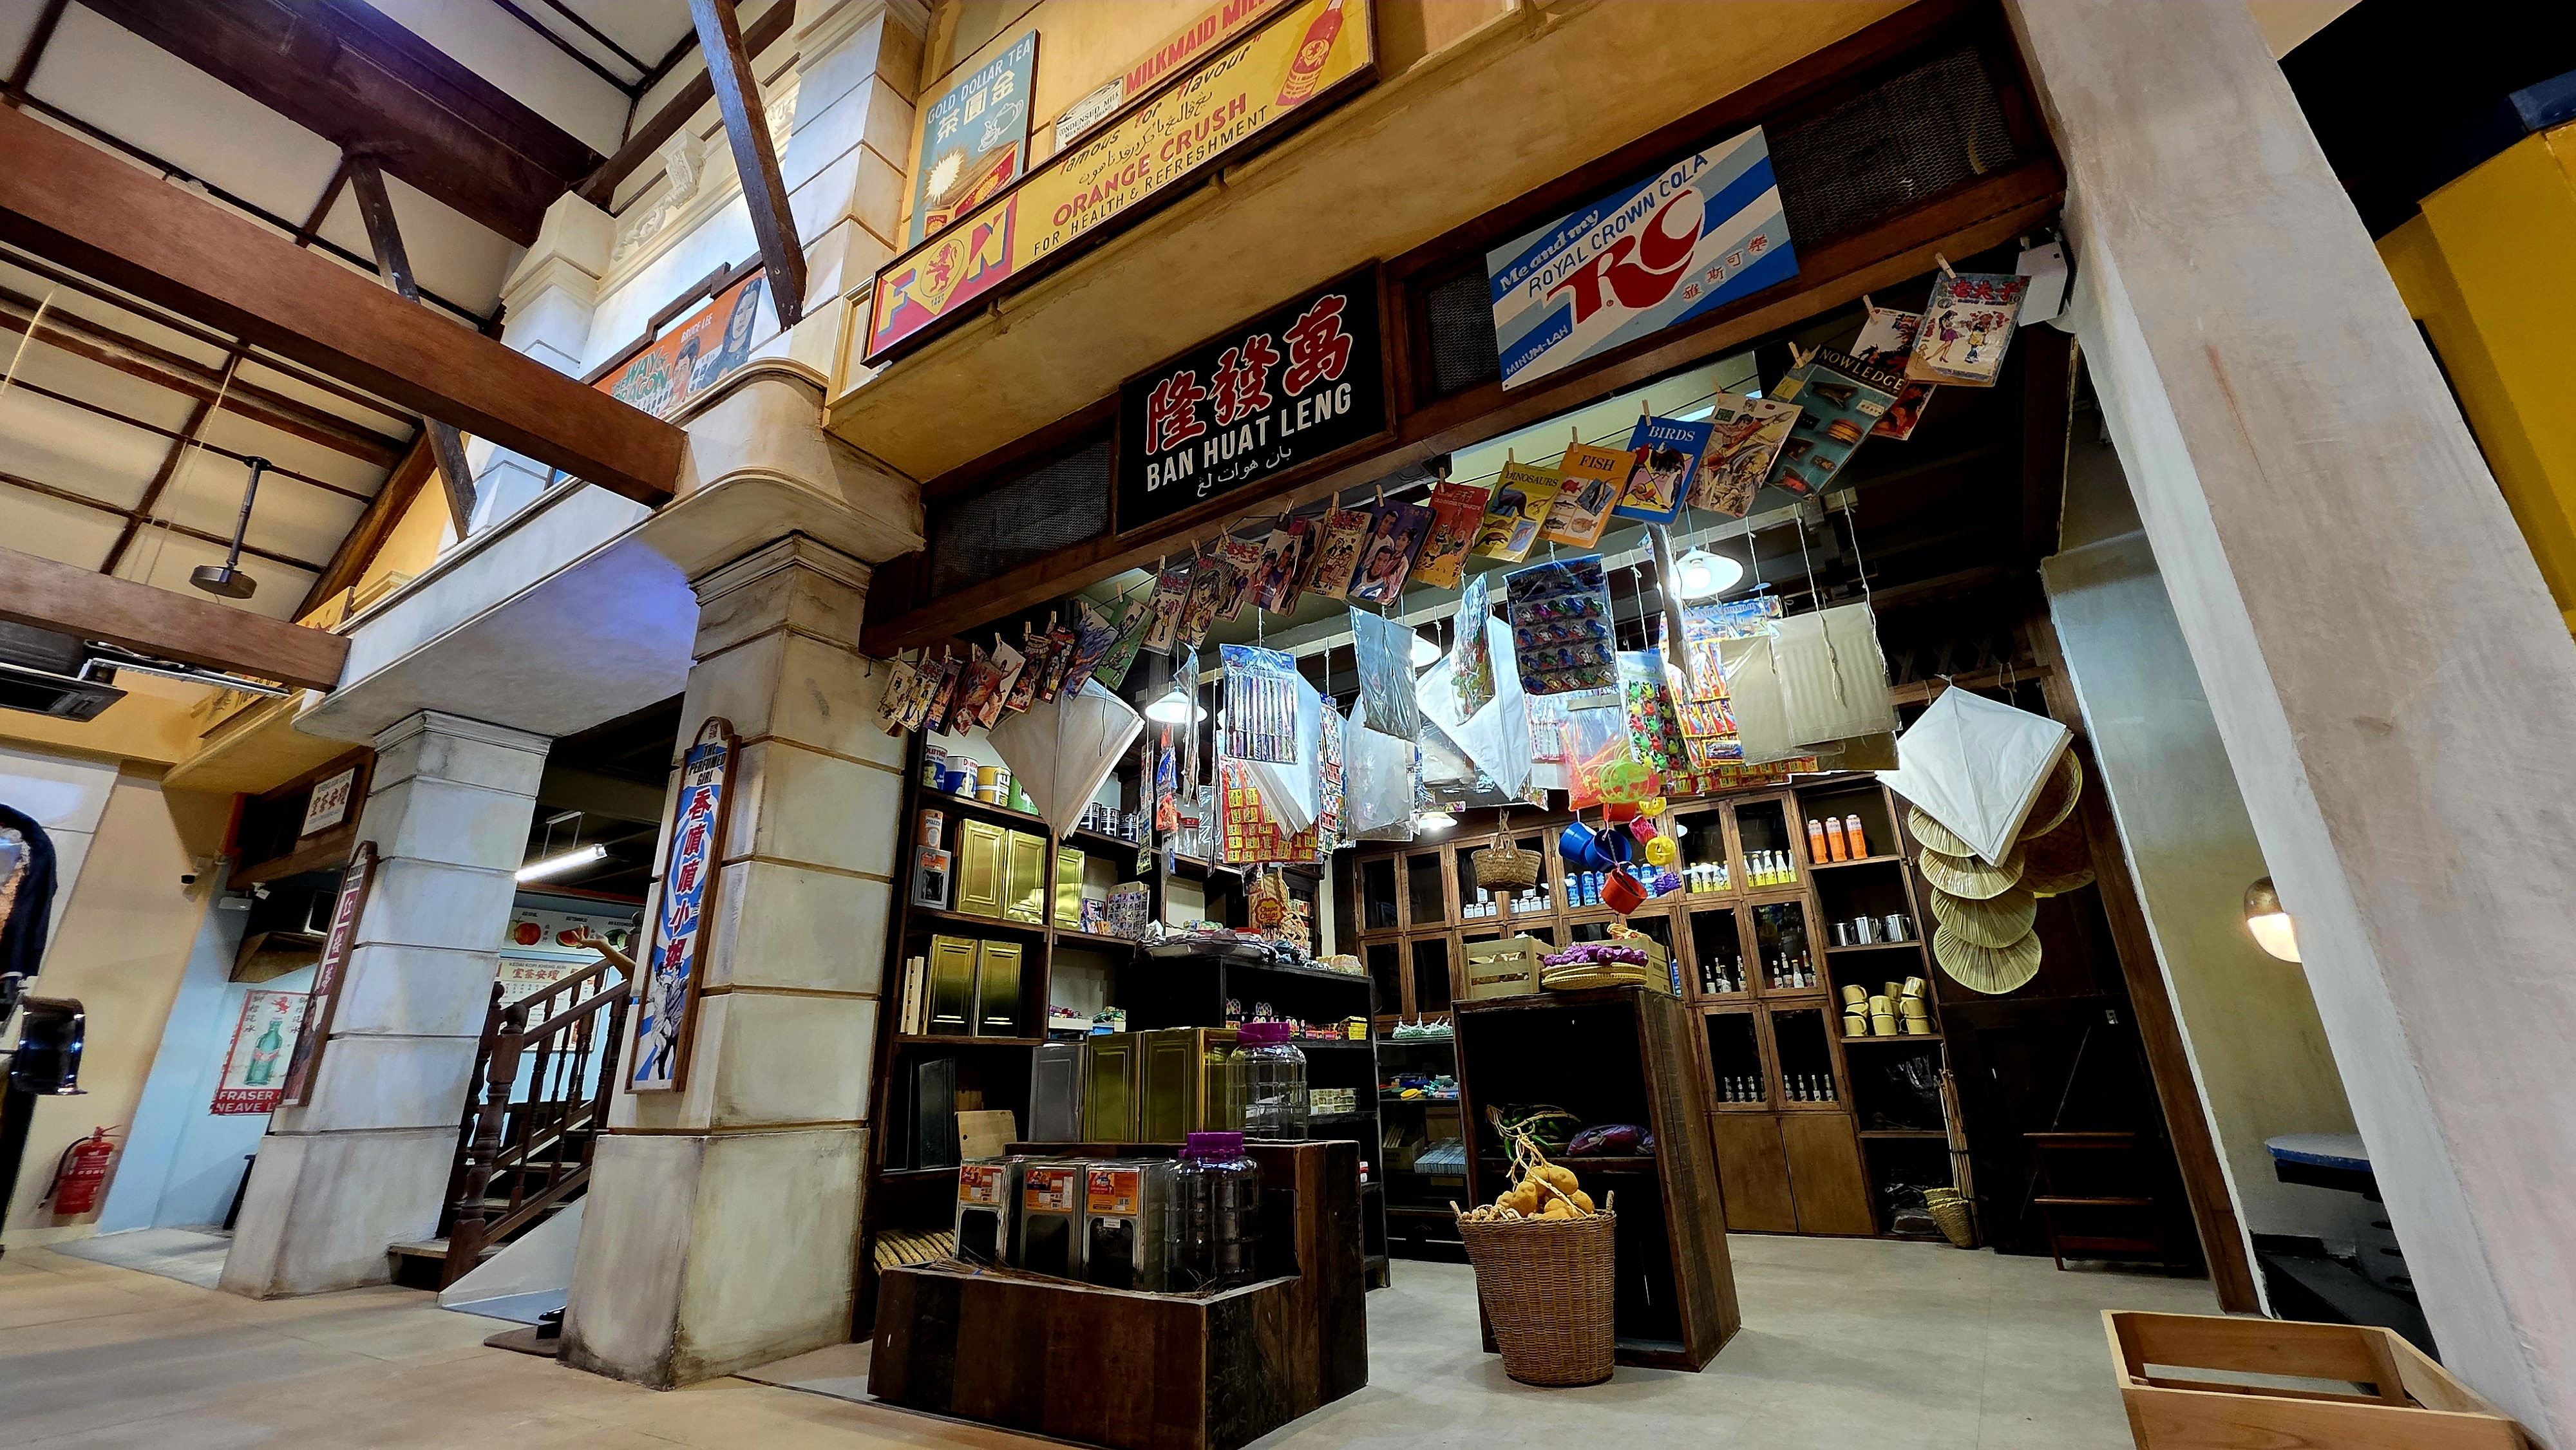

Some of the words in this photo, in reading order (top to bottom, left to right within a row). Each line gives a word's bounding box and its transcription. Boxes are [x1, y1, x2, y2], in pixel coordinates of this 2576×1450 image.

[1126, 15, 1216, 95] MILKMAID
[928, 94, 956, 124] GOLD
[960, 59, 1003, 102] DOLLAR
[1009, 39, 1030, 66] TEA
[1059, 106, 1100, 137] CONDENSED
[1103, 91, 1119, 108] MILK
[1033, 231, 1060, 256] FOR
[1071, 193, 1124, 236] HEALTH
[1130, 187, 1139, 200] &
[1144, 105, 1269, 193] REFRESHMENT
[1052, 153, 1151, 227] ORANGE
[1160, 93, 1247, 163] CRUSH
[1529, 246, 1589, 298] ROYAL
[1591, 192, 1655, 250] CROWN
[1659, 154, 1709, 198] COLA
[1499, 258, 1530, 292] Me
[1530, 229, 1568, 269] and
[1567, 209, 1599, 239] my
[1546, 189, 1703, 325] RC
[680, 321, 701, 344] BRUCE
[701, 312, 714, 330] LEE
[627, 345, 665, 385] WAY
[1506, 325, 1569, 375] MINUM-LAH
[1819, 349, 1905, 391] NOWLEDGE
[1147, 448, 1193, 492] BAN
[1204, 415, 1271, 469] HUAT
[1281, 382, 1352, 438] LENG
[1647, 426, 1696, 442] BIRDS
[1504, 471, 1559, 487] DINOSAURS
[1578, 455, 1616, 472] FISH
[688, 752, 727, 776] PERFUMED
[703, 742, 718, 757] THE
[696, 769, 714, 786] GIRL
[214, 1102, 261, 1113] NEAVE
[218, 1090, 274, 1101] FRASER
